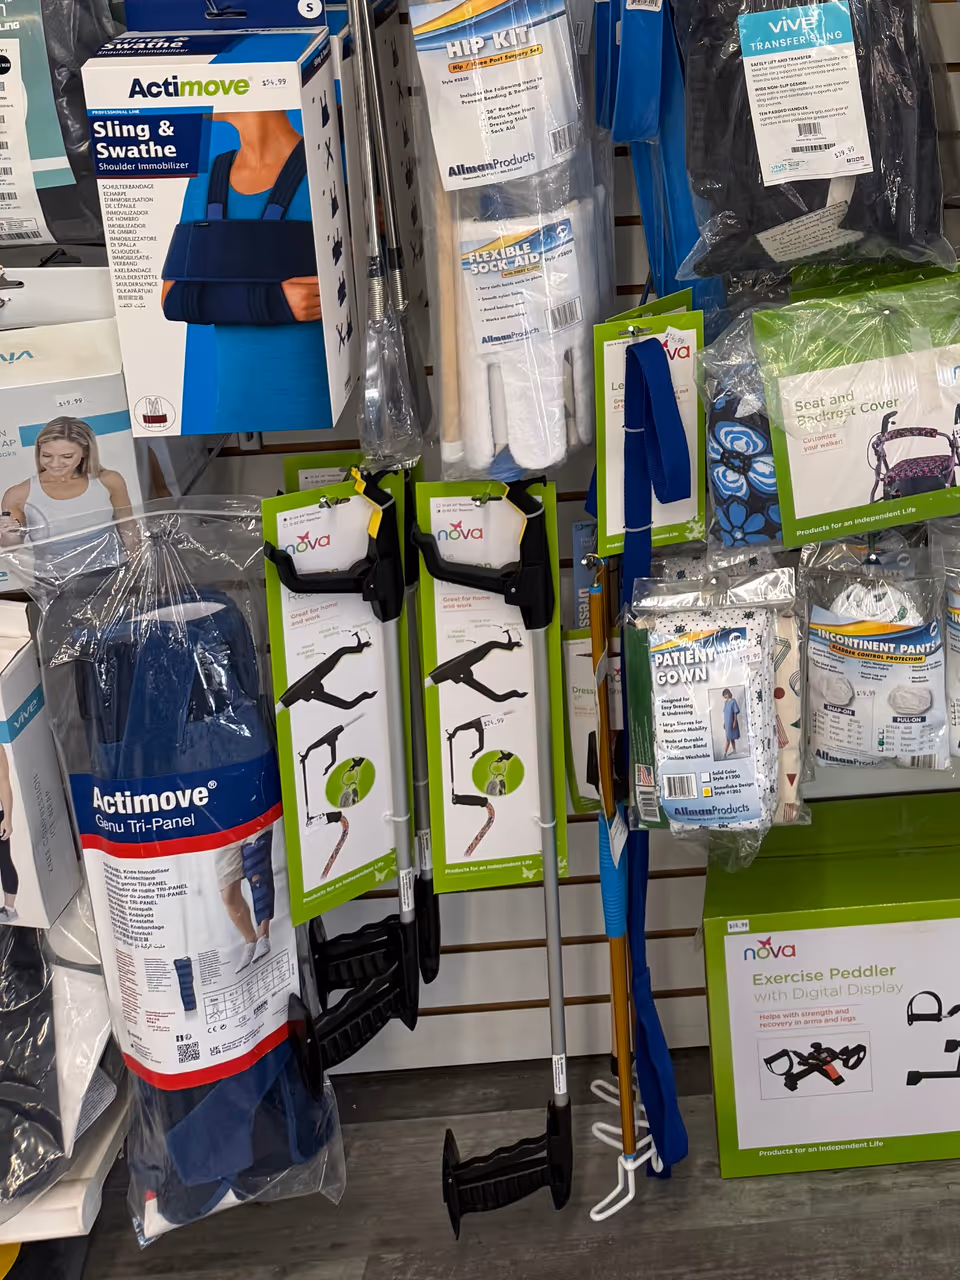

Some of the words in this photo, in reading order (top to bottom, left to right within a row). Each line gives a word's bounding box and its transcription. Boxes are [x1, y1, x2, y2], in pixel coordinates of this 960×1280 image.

[447, 37, 484, 58] HIP
[492, 27, 528, 49] KIT
[750, 35, 805, 51] TRANSFER
[810, 31, 843, 42] SLING
[128, 79, 250, 99] Actimove
[262, 78, 287, 87] $54.99
[94, 121, 150, 140] Sling
[158, 121, 175, 136] &
[96, 142, 177, 158] Swathe
[98, 162, 136, 171] Shoulder
[138, 160, 189, 171] Immobilizer
[469, 243, 531, 262] FLEXIBLE
[471, 260, 508, 274] SOCK
[514, 253, 540, 267] AID
[795, 400, 824, 411] Seat
[831, 392, 854, 405] and
[797, 408, 856, 426] Backrest
[860, 398, 899, 413] Cover
[802, 432, 837, 444] Customize
[820, 439, 843, 450] walker!
[654, 648, 715, 666] PATIENT
[656, 672, 708, 685] GOWN
[93, 787, 209, 815] Actimove
[96, 814, 124, 832] Genu
[128, 814, 195, 833] Tri-Panel
[744, 945, 796, 960] nova
[752, 971, 824, 986] Exercise
[829, 965, 896, 979] Peddler
[754, 991, 788, 1002] with
[792, 987, 842, 1001] Digital
[847, 983, 904, 998] Display
[801, 1010, 832, 1018] strength
